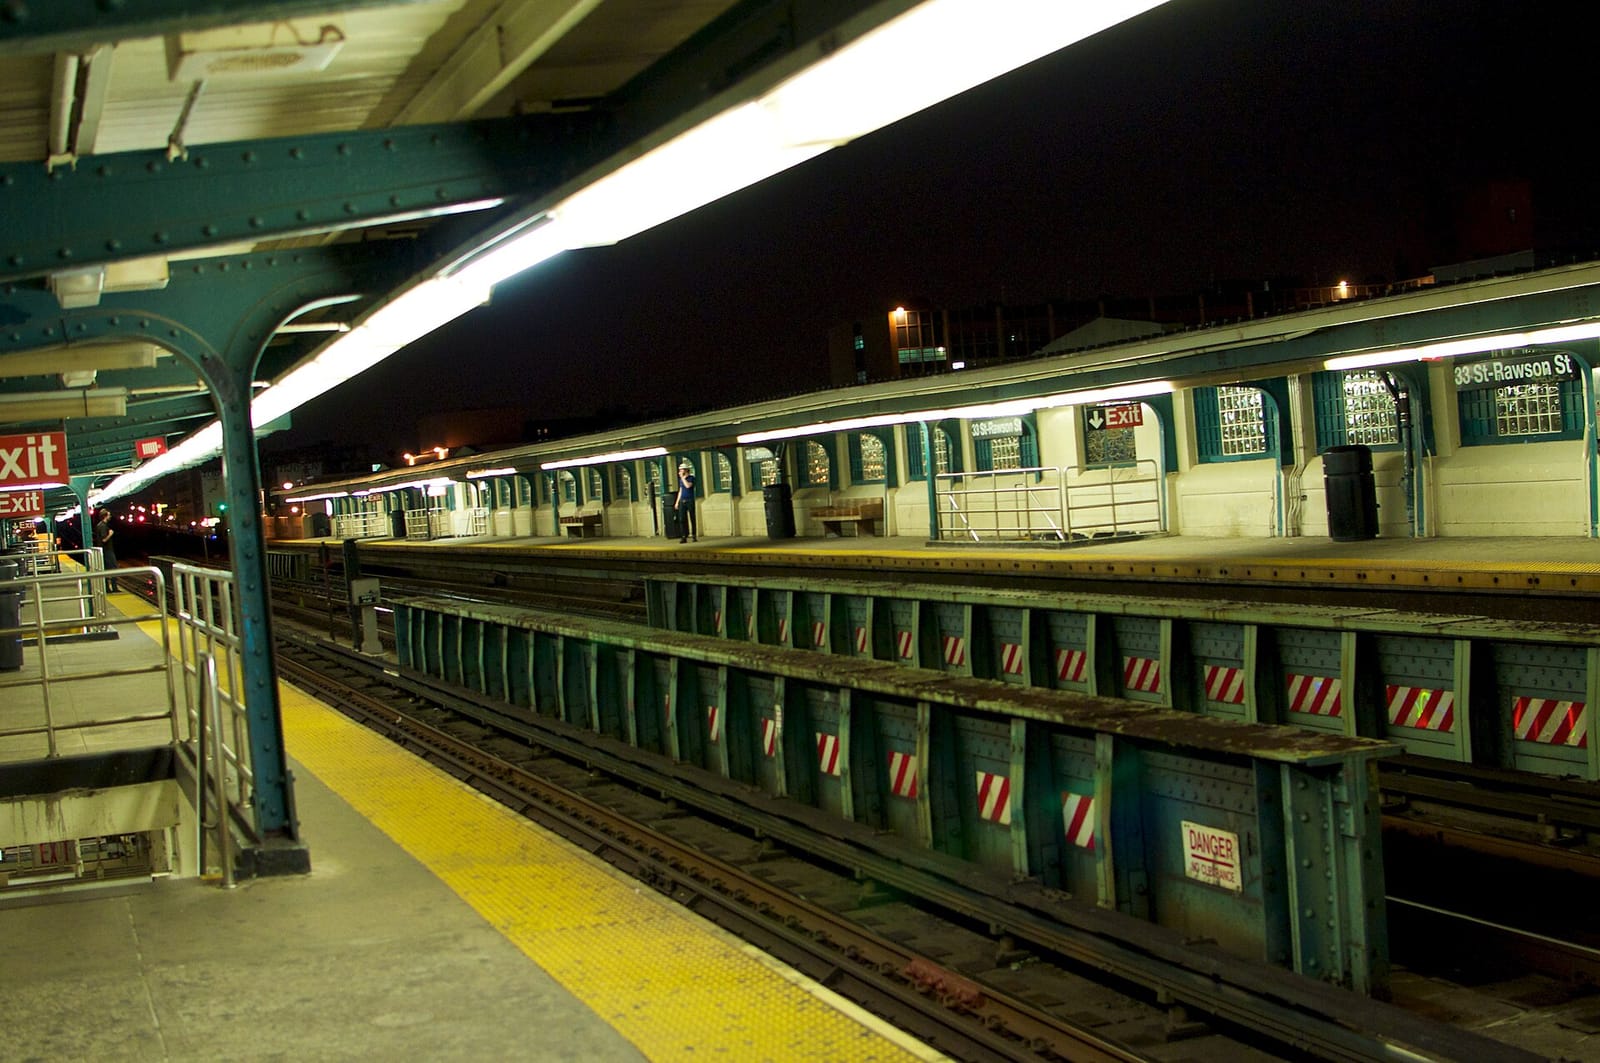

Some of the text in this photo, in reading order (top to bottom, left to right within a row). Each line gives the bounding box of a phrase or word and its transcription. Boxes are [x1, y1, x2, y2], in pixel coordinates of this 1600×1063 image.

[1454, 354, 1573, 385] 33 St-Rawson St
[1105, 404, 1141, 426] Exit
[0, 435, 59, 480] xit
[0, 491, 40, 513] Exit
[1189, 829, 1233, 859] DANGER
